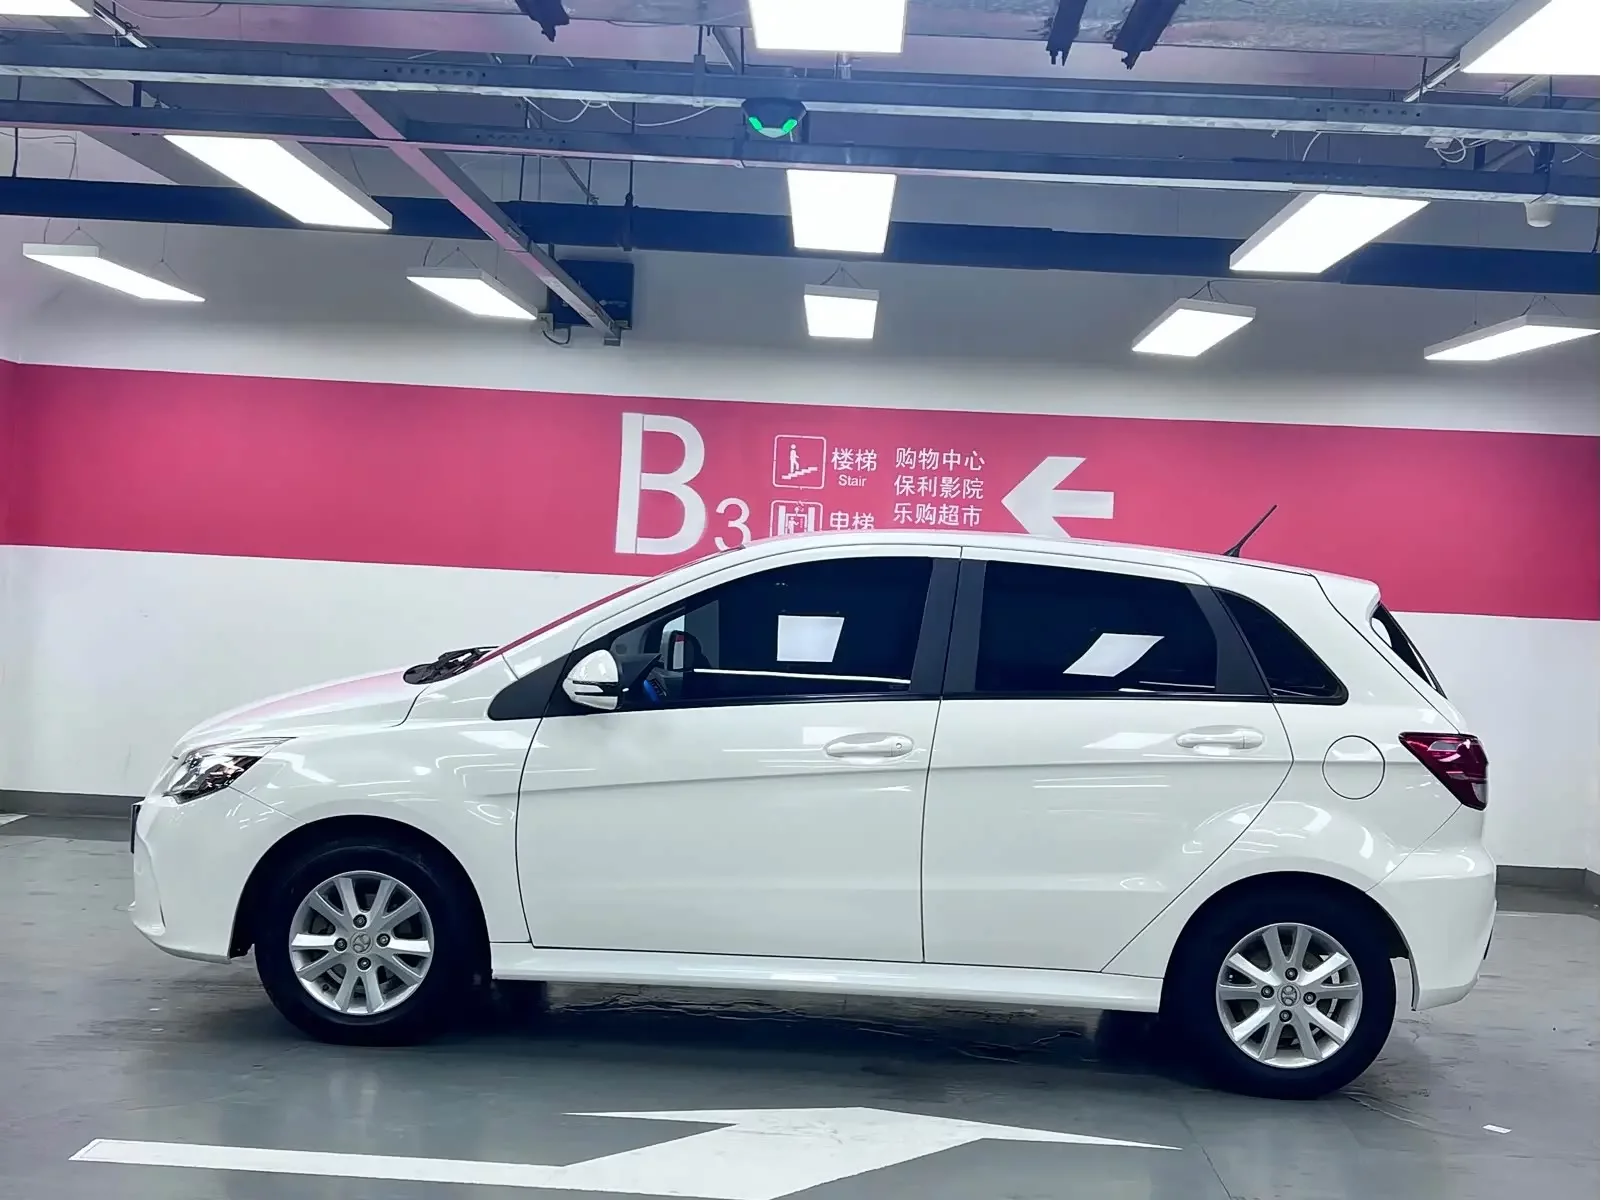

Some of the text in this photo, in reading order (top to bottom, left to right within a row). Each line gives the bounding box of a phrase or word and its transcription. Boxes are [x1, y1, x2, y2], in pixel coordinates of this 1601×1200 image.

[831, 447, 877, 471] 楼梯
[895, 447, 985, 471] 购物中心
[838, 475, 867, 487] Stair
[894, 475, 984, 499] 保利影院
[893, 503, 983, 527] 乐购超市
